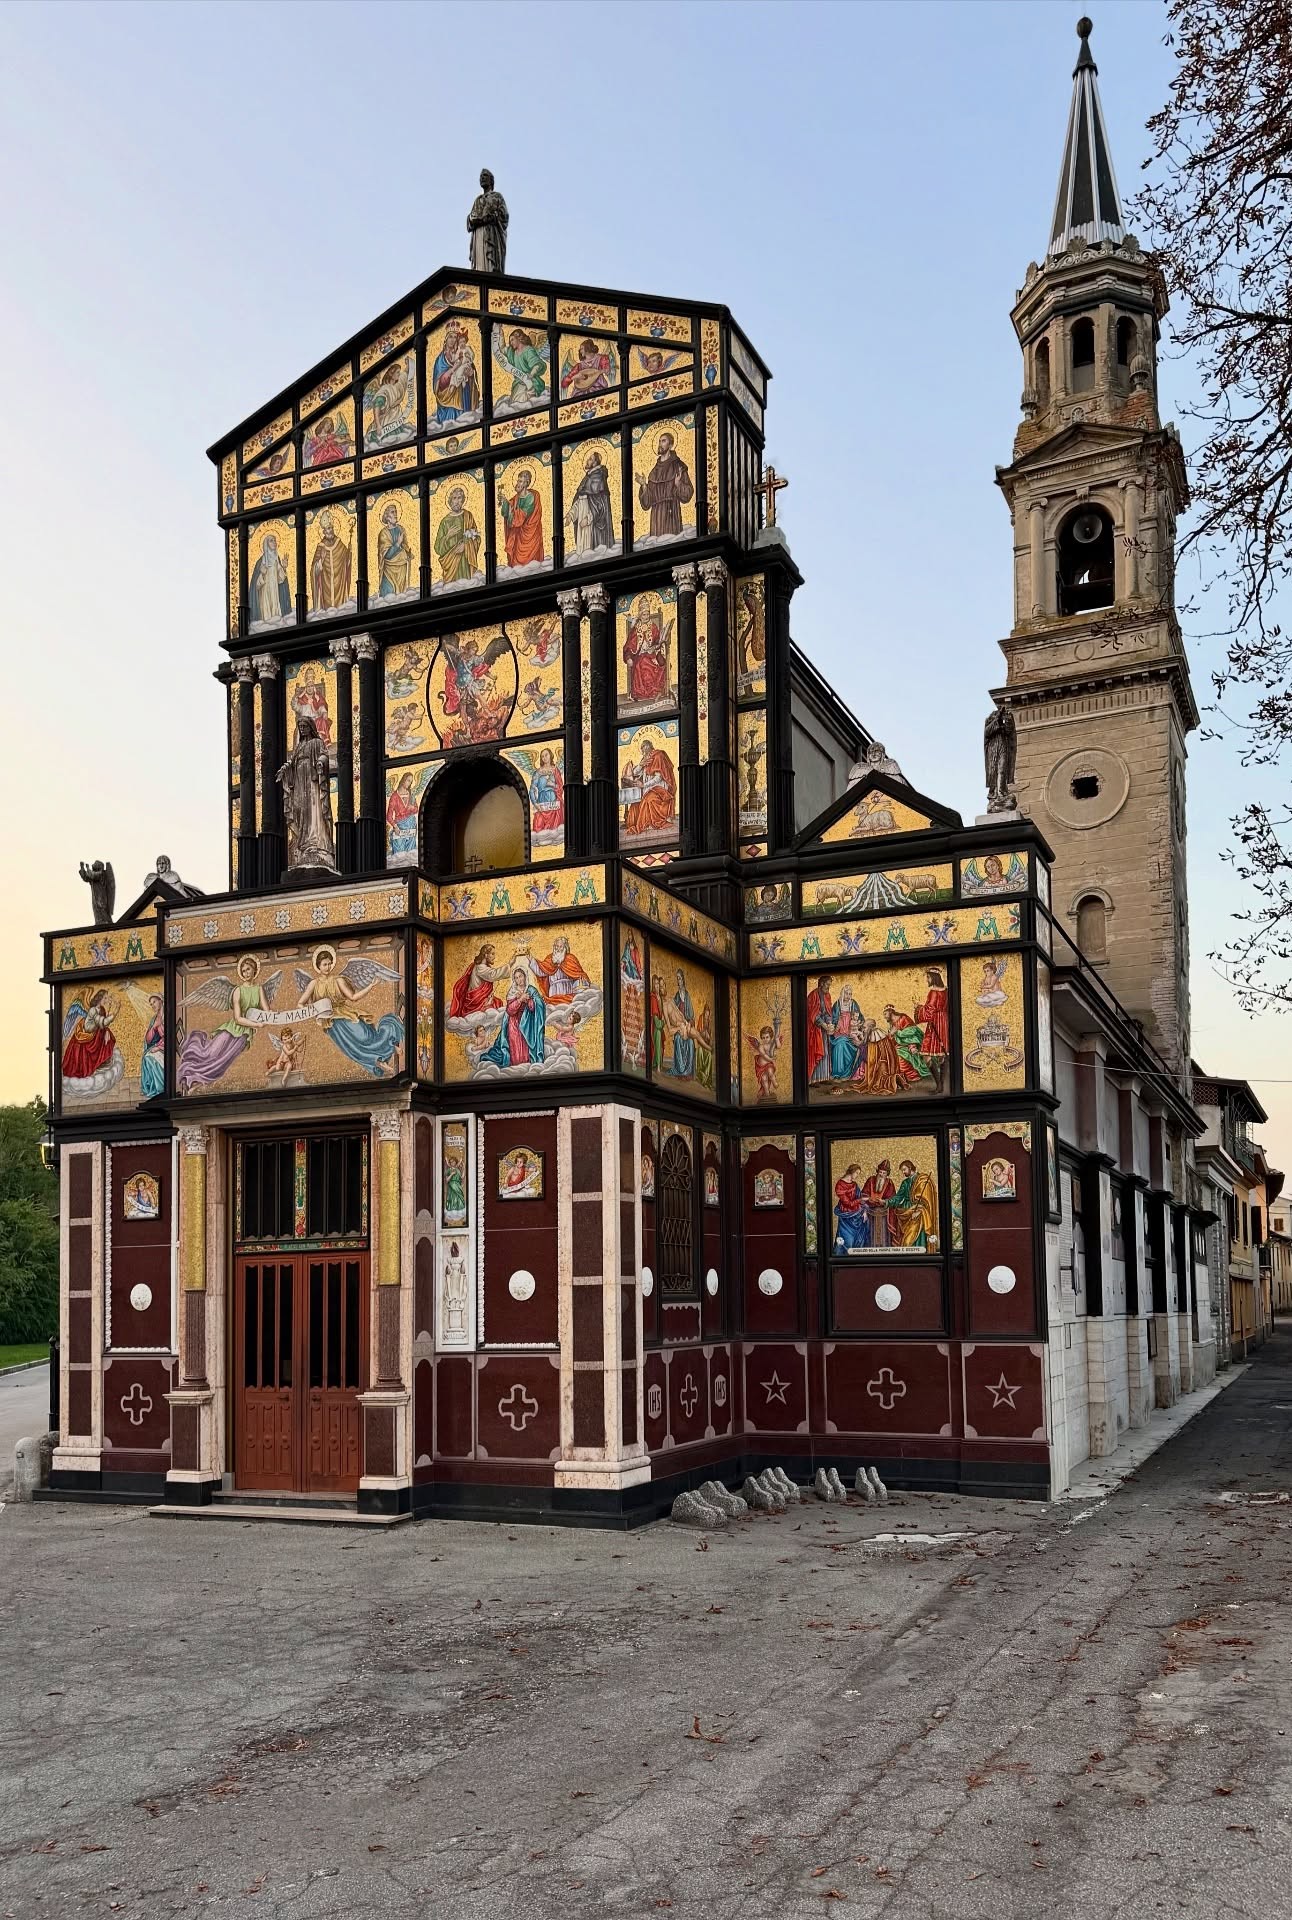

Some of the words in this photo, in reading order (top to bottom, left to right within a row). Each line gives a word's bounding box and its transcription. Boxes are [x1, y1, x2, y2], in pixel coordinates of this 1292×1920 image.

[382, 416, 407, 434] NOSTRA
[638, 726, 664, 739] AGOSTINO
[256, 1011, 280, 1024] AVE
[285, 1004, 319, 1022] MARIA
[715, 1380, 726, 1401] IHS
[649, 1390, 661, 1414] IHS
